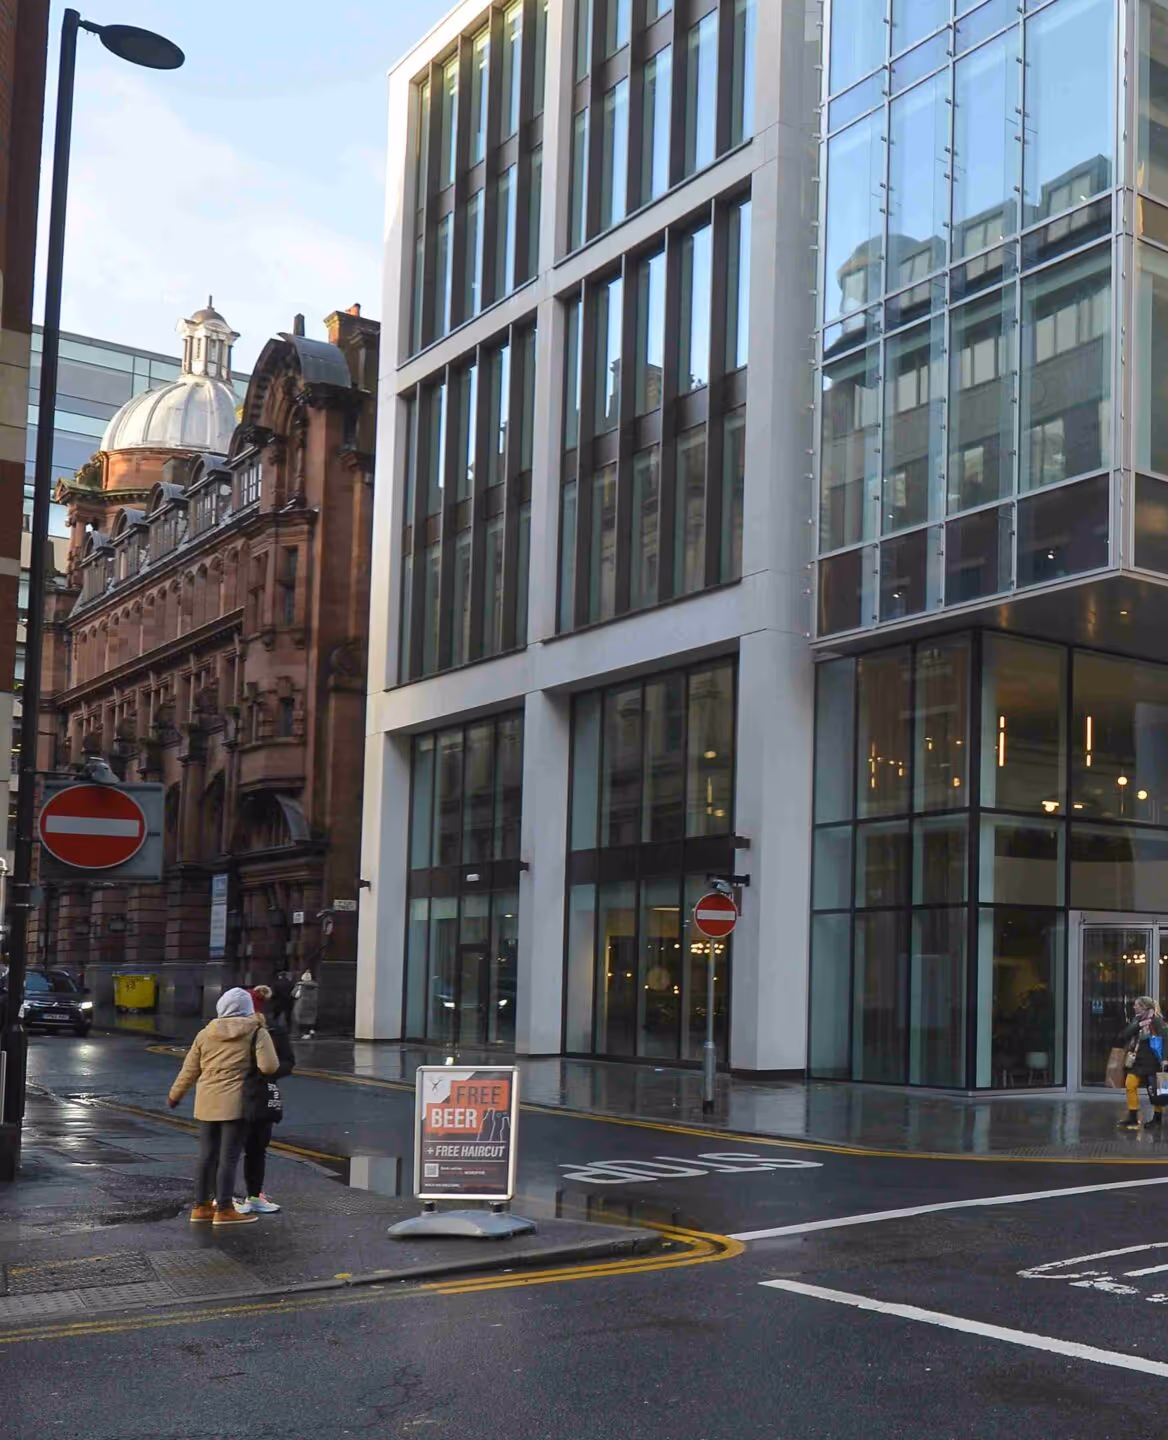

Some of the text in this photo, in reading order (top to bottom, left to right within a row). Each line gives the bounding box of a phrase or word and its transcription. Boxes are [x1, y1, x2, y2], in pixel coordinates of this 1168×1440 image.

[456, 1085, 502, 1105] FREE
[431, 1107, 478, 1129] BEER
[435, 1145, 460, 1157] FREE
[461, 1145, 505, 1158] HAIRCUT
[558, 1152, 824, 1184] STOP
